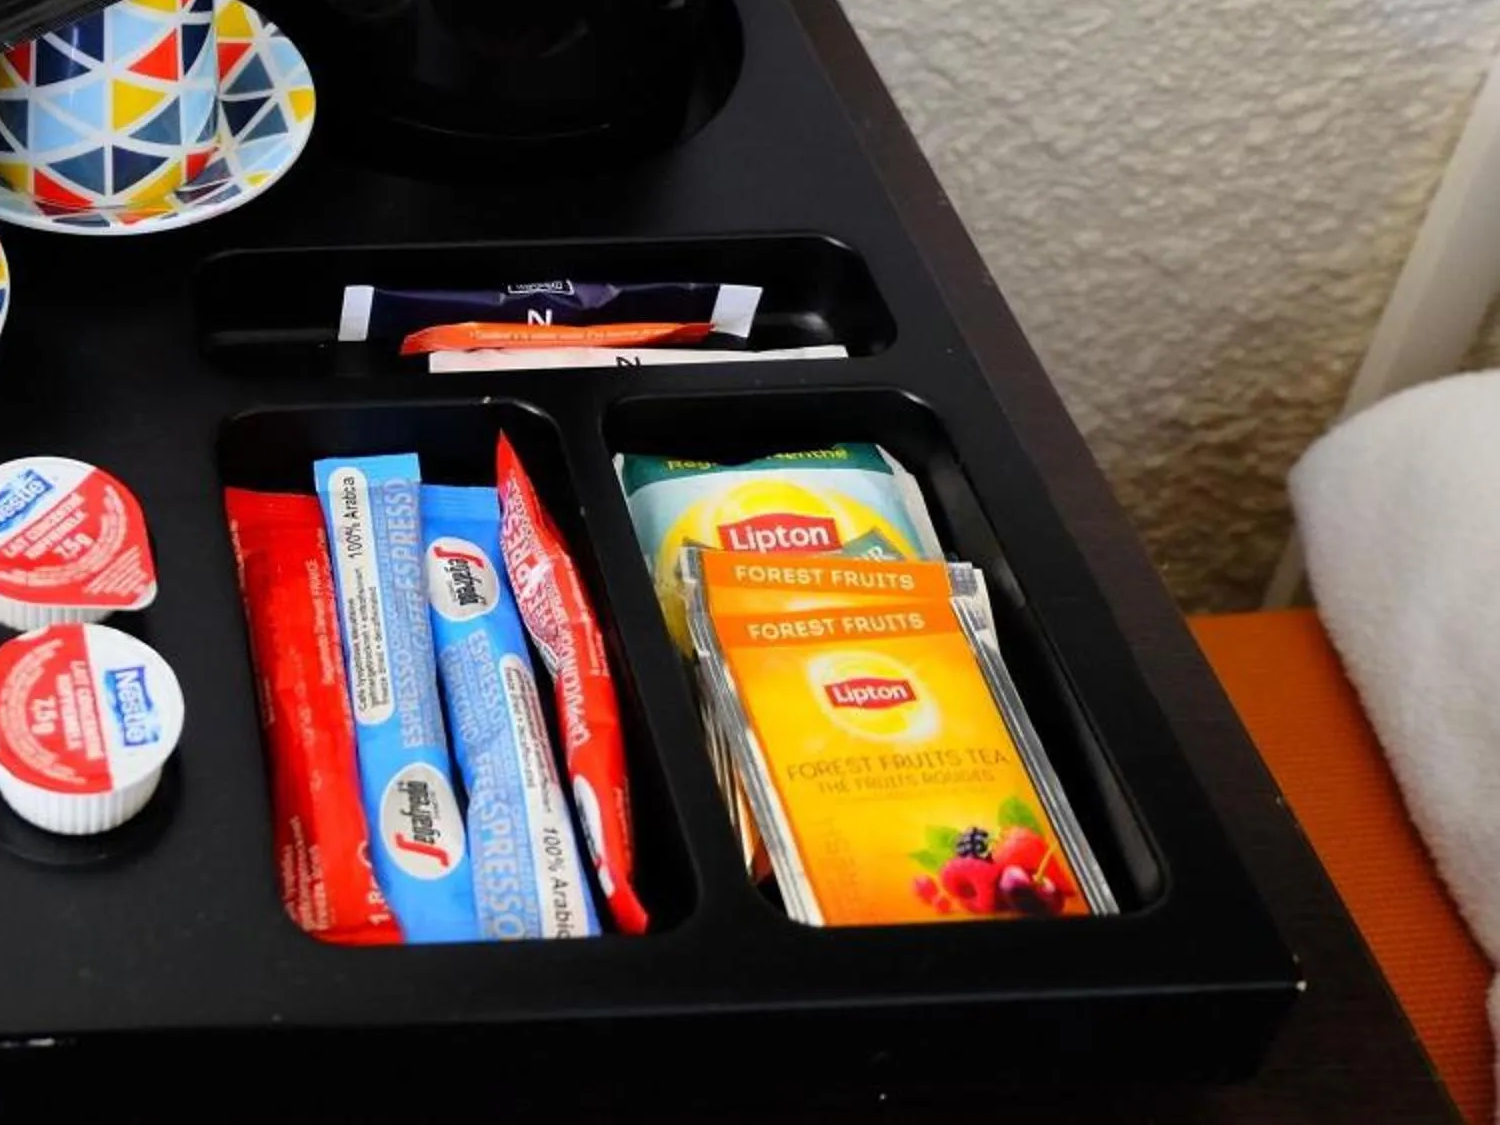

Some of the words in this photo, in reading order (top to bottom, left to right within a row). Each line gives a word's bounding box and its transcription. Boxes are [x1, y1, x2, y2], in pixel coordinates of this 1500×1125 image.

[343, 523, 363, 558] 100%
[729, 526, 829, 553] Lipton
[735, 565, 823, 586] FOREST
[831, 569, 915, 591] FRUITS
[747, 617, 836, 641] FOREST
[843, 612, 925, 634] FRUITS
[831, 683, 909, 706] Lipton
[787, 755, 874, 780] FOREST
[881, 750, 959, 772] FRUITS
[965, 748, 1011, 767] TEA
[543, 827, 563, 872] 100%
[550, 876, 574, 940] Arabic
